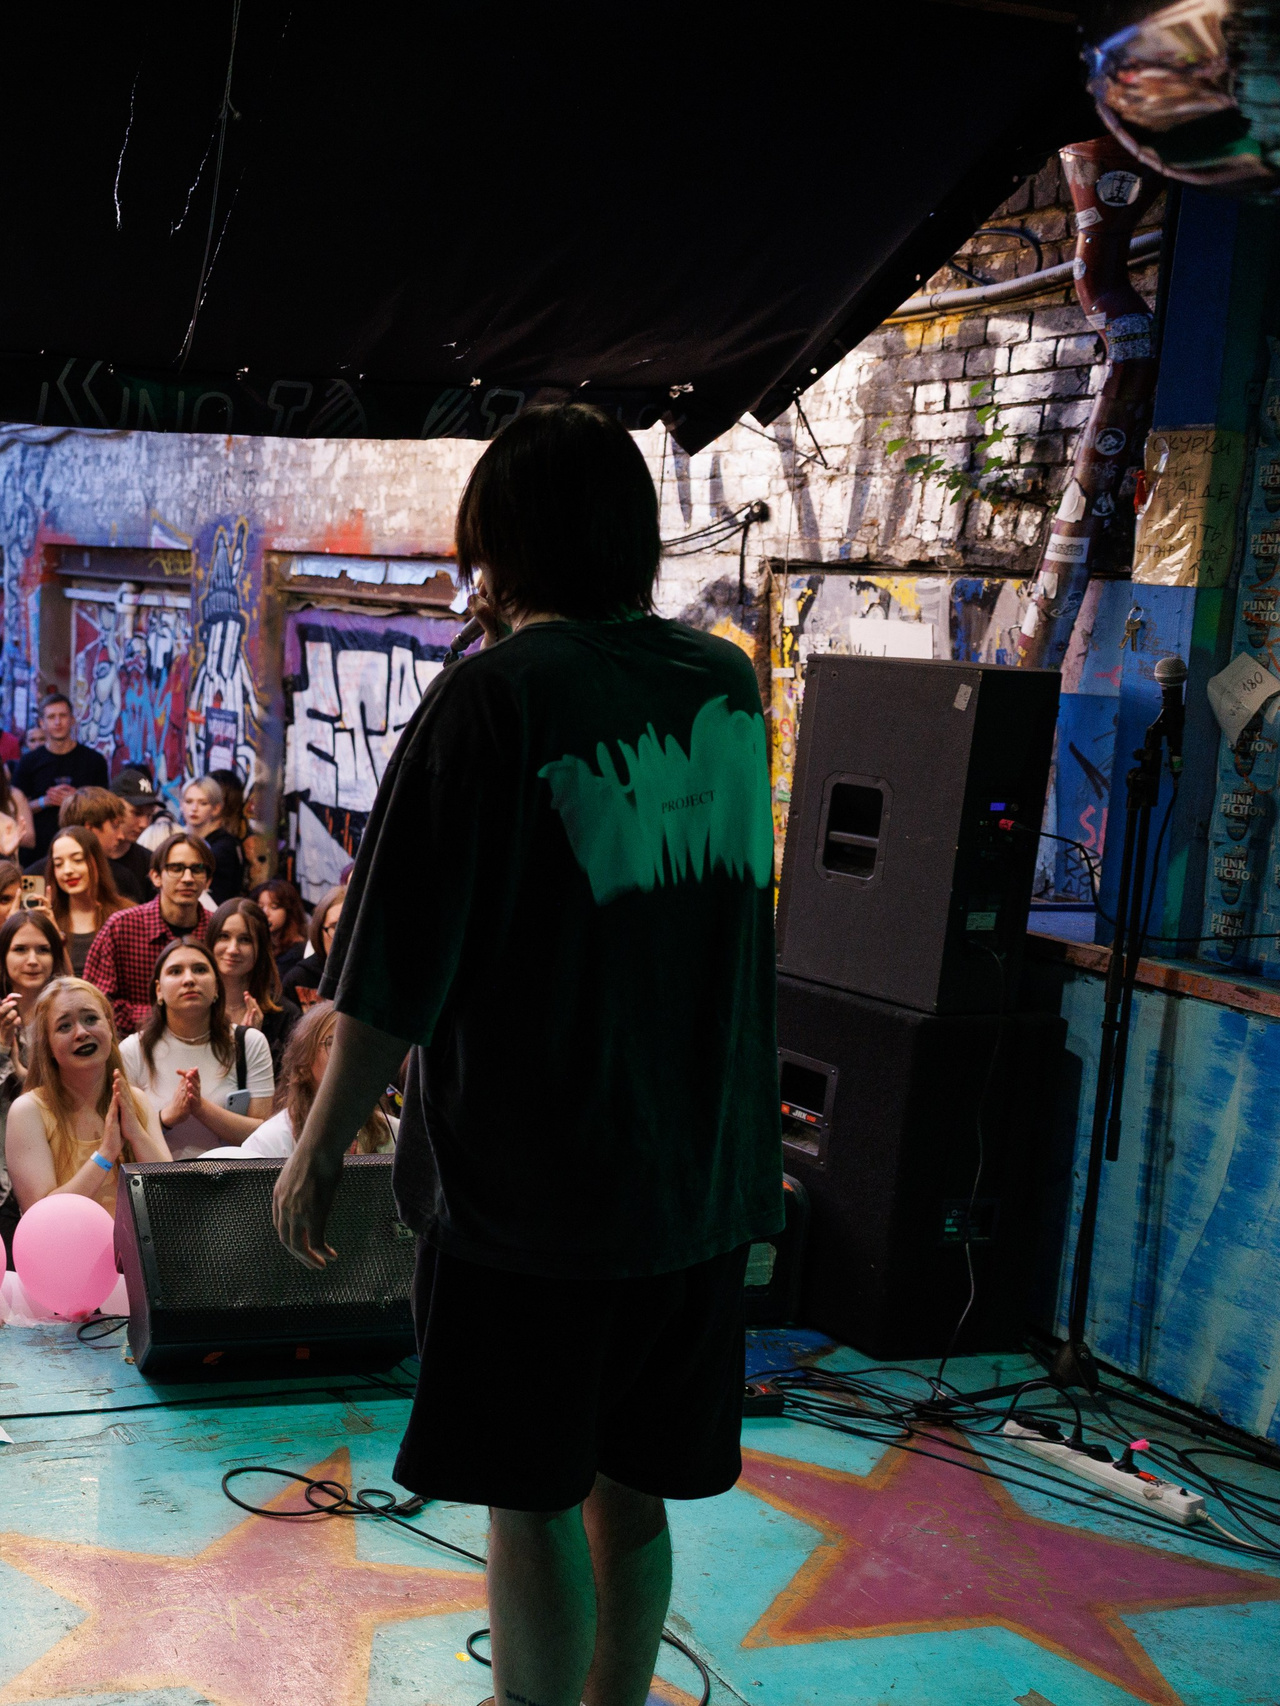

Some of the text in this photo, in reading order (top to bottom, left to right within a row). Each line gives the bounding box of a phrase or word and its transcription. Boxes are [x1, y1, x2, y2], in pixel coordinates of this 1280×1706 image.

[1153, 435, 1231, 455] ОКУРКИ
[1144, 481, 1231, 502] ЕРАНДЕ
[1242, 671, 1263, 693] 180
[661, 789, 715, 815] PROJECT
[1222, 793, 1254, 806] PUNK
[1214, 856, 1246, 870] PUNK
